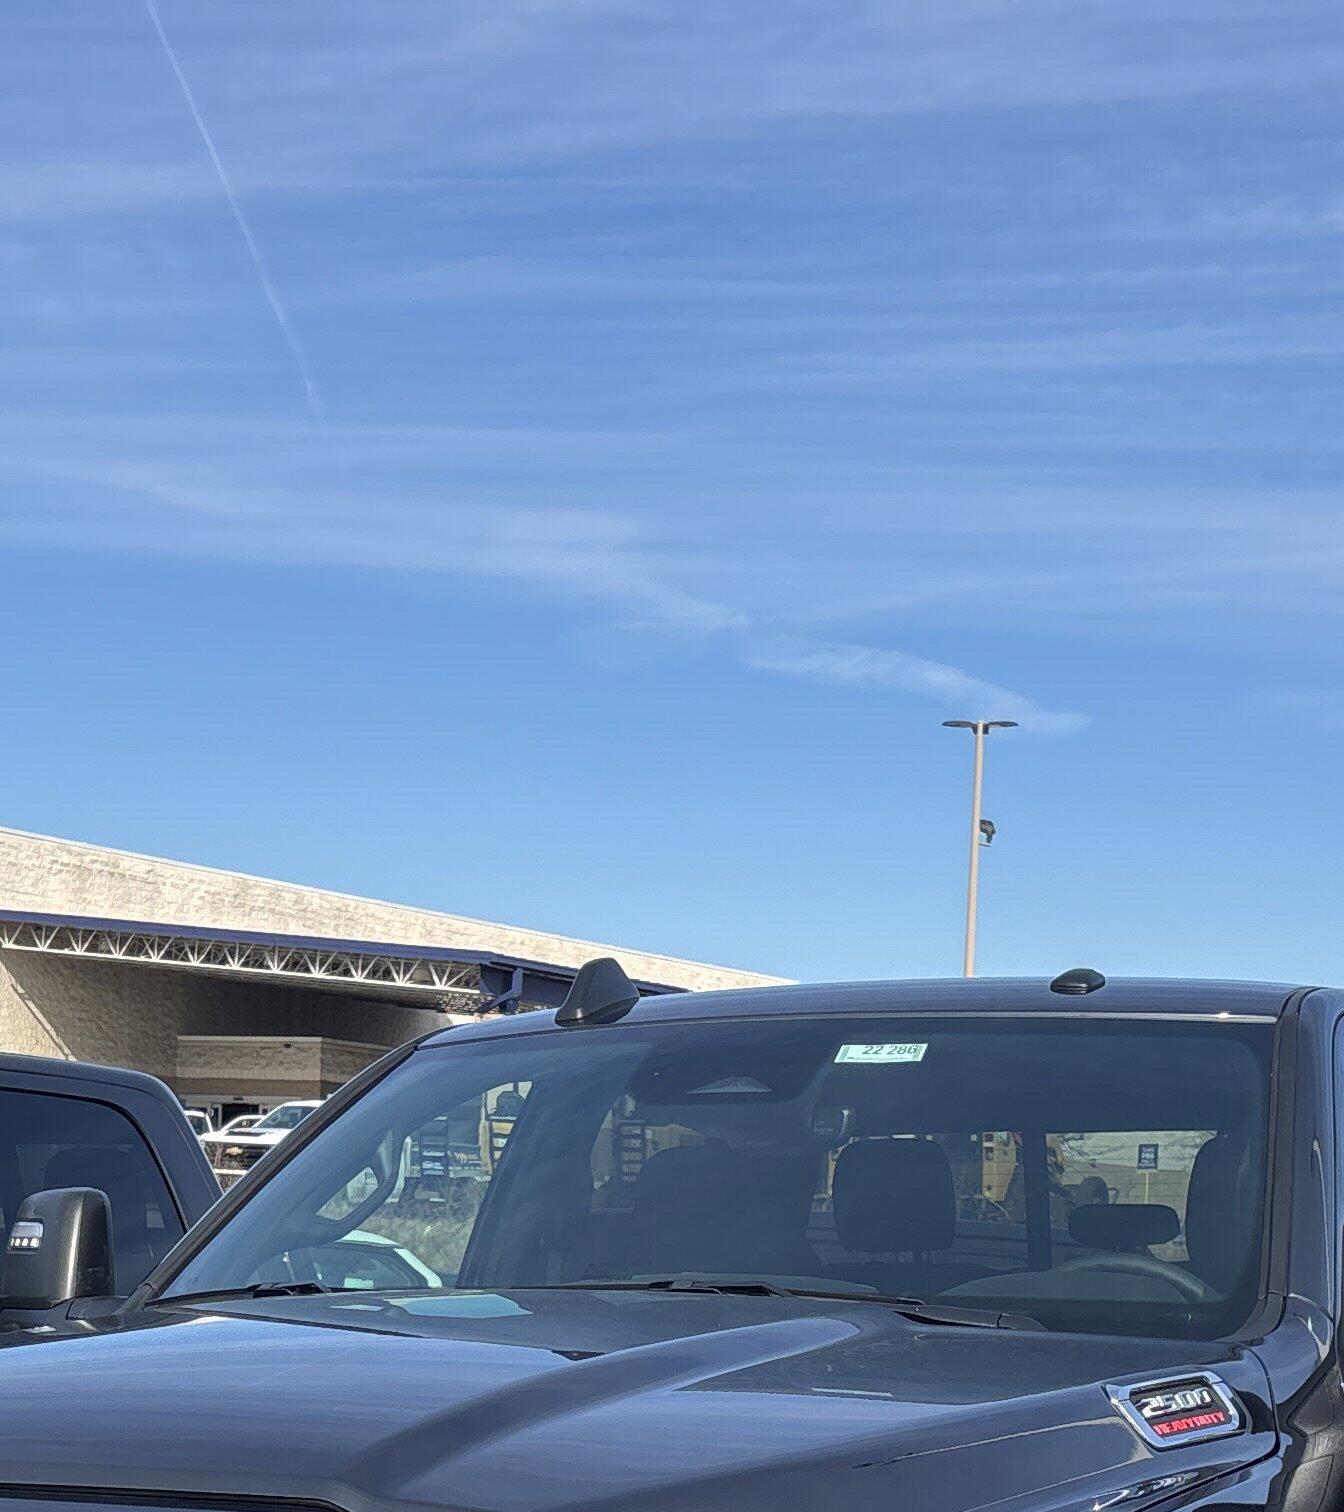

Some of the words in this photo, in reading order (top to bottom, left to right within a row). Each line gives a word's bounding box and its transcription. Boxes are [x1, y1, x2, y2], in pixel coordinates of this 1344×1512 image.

[1136, 1388, 1211, 1418] 2500
[1152, 1417, 1195, 1435] HEAVY
[1192, 1411, 1226, 1427] DUTY
